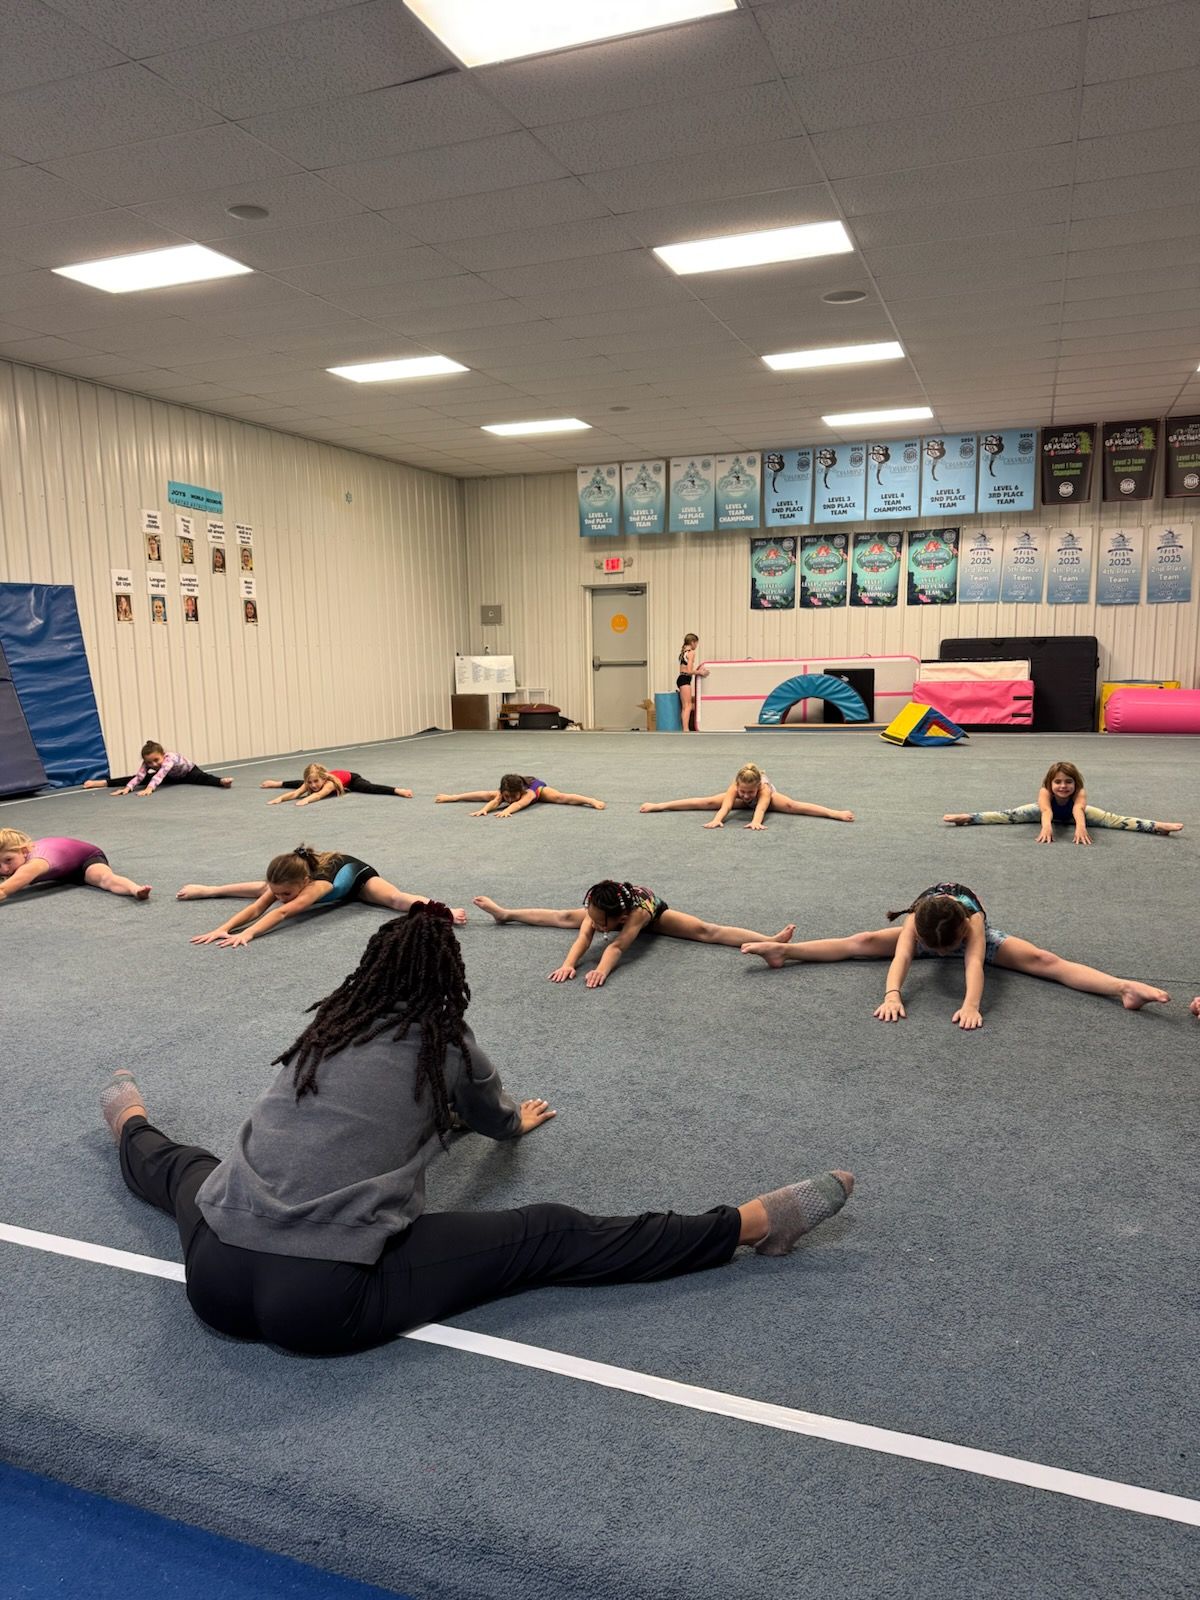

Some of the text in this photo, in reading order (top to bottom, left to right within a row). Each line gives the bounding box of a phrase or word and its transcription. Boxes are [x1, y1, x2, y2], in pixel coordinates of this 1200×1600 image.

[874, 505, 912, 513] CHAMPIONS
[719, 515, 754, 523] CHAMPIONS
[970, 557, 991, 565] 2025
[1014, 556, 1035, 564] 2025
[1058, 557, 1080, 565] 2025
[1109, 558, 1131, 566] 2025
[1159, 555, 1181, 564] 2025
[605, 557, 621, 571] EXIT
